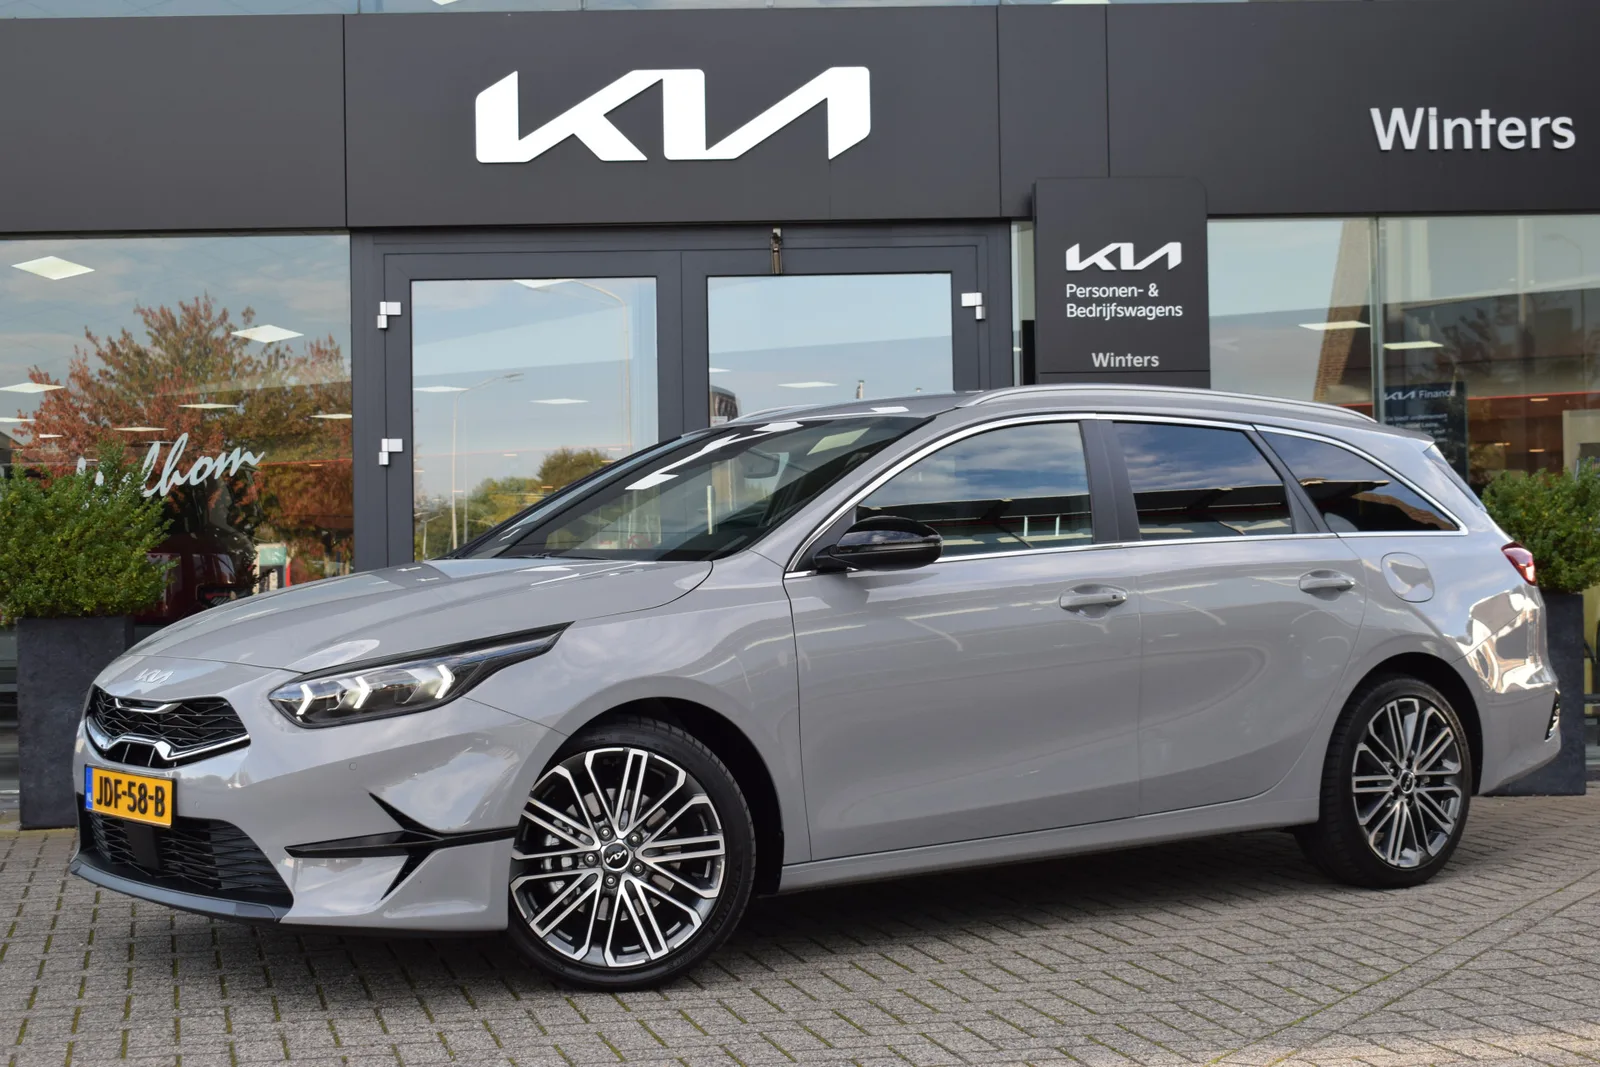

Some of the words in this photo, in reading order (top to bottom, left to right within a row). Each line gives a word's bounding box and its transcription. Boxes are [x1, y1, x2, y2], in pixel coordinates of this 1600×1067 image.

[475, 66, 871, 163] KIA
[1369, 106, 1576, 151] Winters
[1065, 241, 1182, 271] KIA
[1066, 283, 1144, 298] Personen-
[1148, 282, 1159, 297] &
[1066, 302, 1183, 321] Bedrijfswagens
[1091, 352, 1160, 367] Winters
[135, 669, 173, 684] KIA
[97, 776, 165, 817] JDF-58-B
